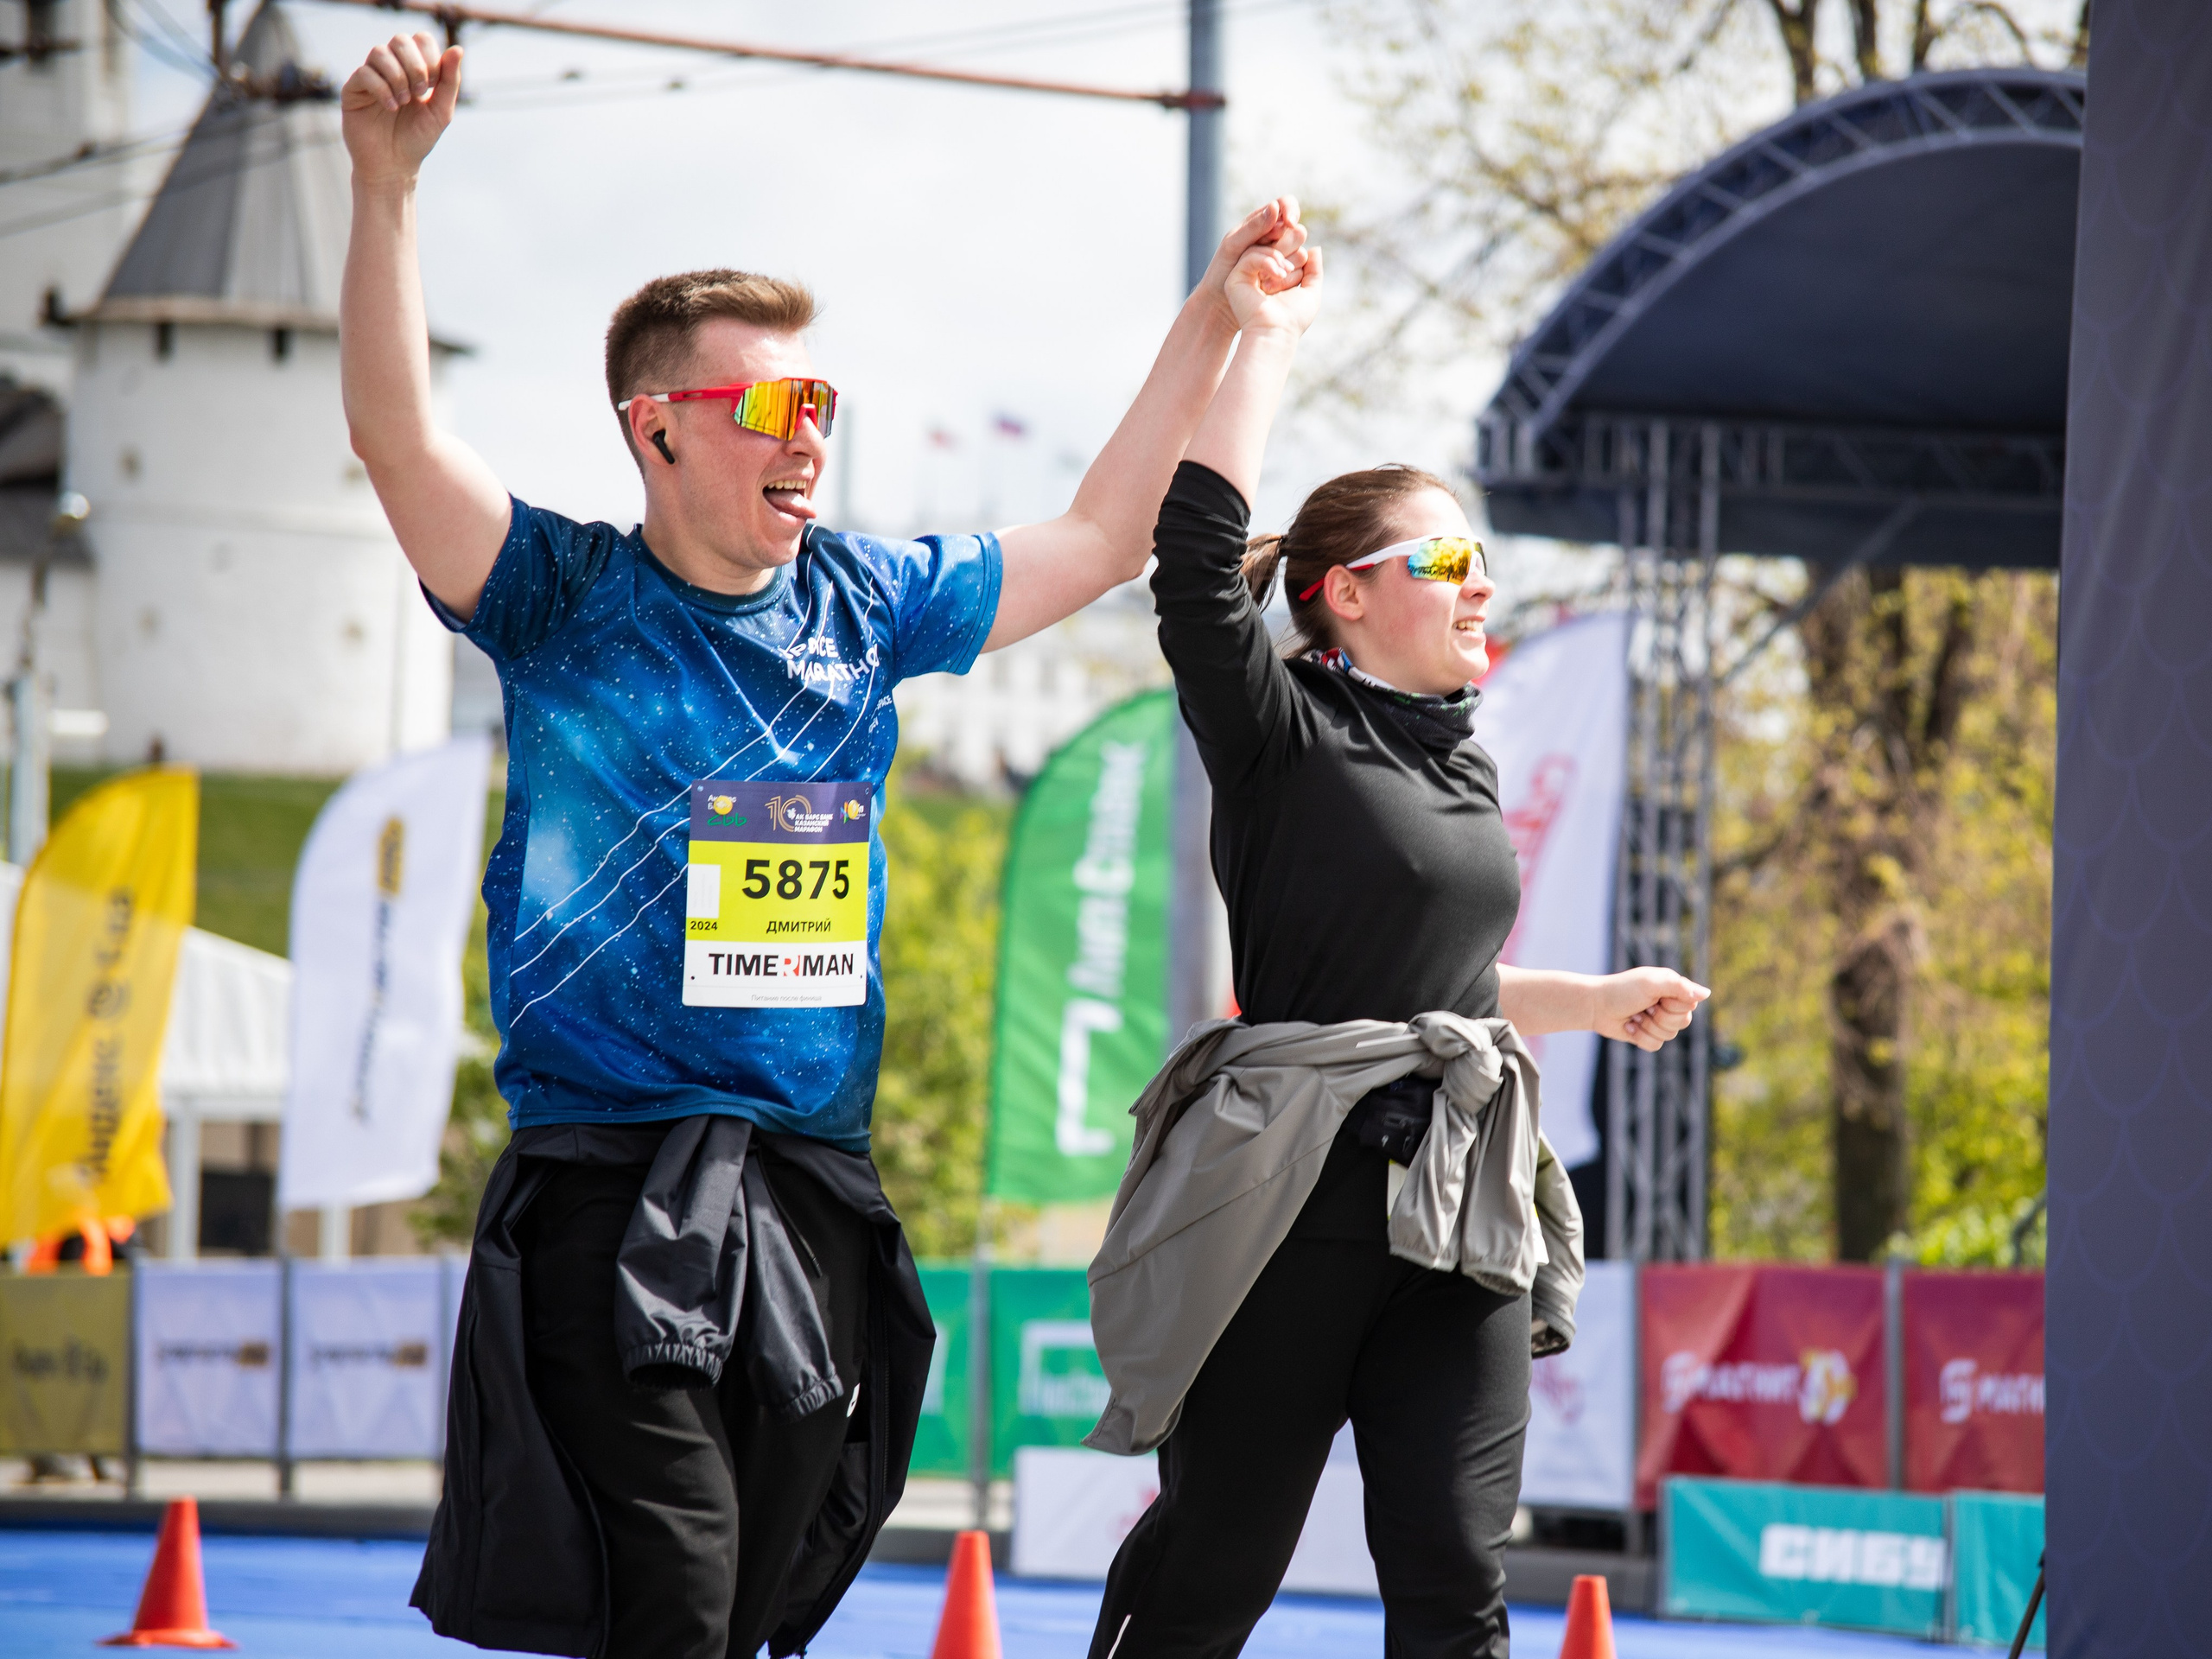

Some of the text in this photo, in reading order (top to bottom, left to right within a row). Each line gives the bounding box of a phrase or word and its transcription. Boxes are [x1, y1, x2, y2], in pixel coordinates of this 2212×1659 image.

[741, 859, 849, 900] 5875
[690, 920, 718, 931] 2024
[766, 918, 831, 934] ДМИТРИЙ
